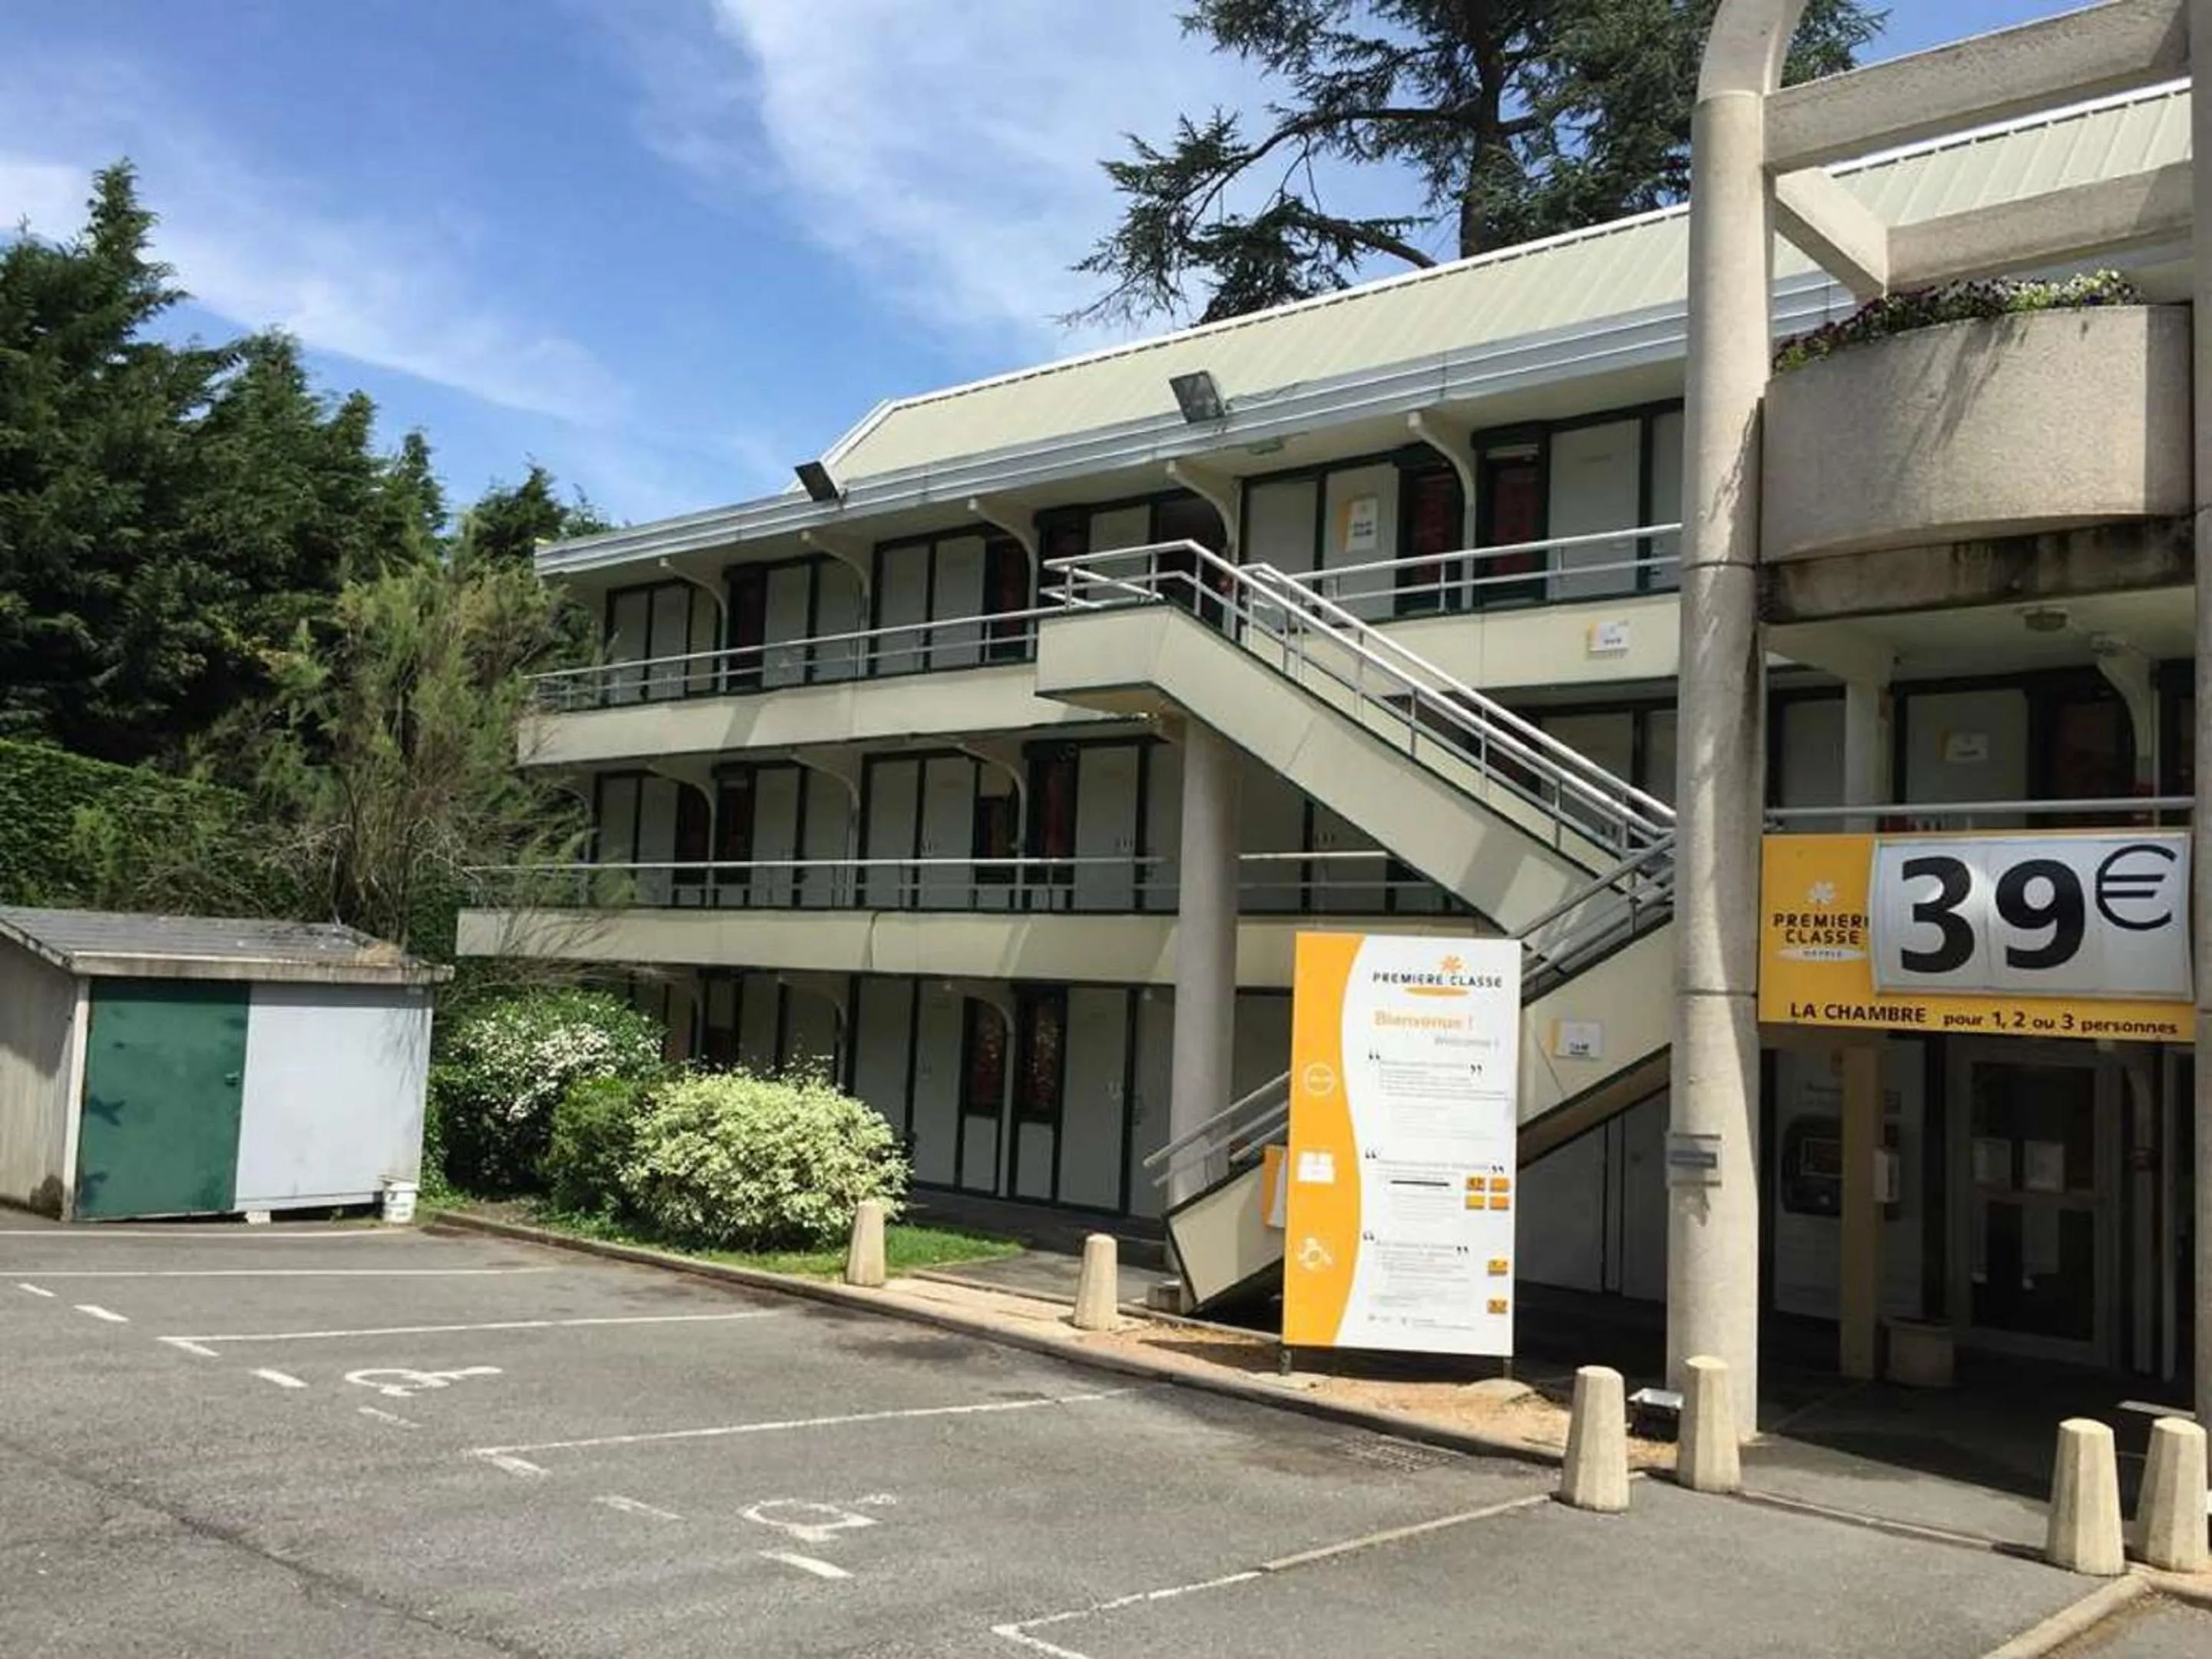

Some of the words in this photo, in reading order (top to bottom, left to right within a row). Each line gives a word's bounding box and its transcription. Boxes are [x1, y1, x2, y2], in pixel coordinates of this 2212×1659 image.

[1785, 929, 1859, 945] CLASSE
[1373, 972, 1444, 986] PREMIERE
[1449, 975, 1503, 988] CLASSE
[1790, 1002, 1816, 1018] LA
[1824, 1003, 1926, 1023] CHAMBRE
[1942, 1012, 1984, 1027] pour
[1992, 1012, 2007, 1029] 1,
[2013, 1012, 2025, 1028] 2
[2032, 1018, 2055, 1030] ou
[2060, 1013, 2075, 1030] 3
[2081, 1018, 2178, 1035] personnes
